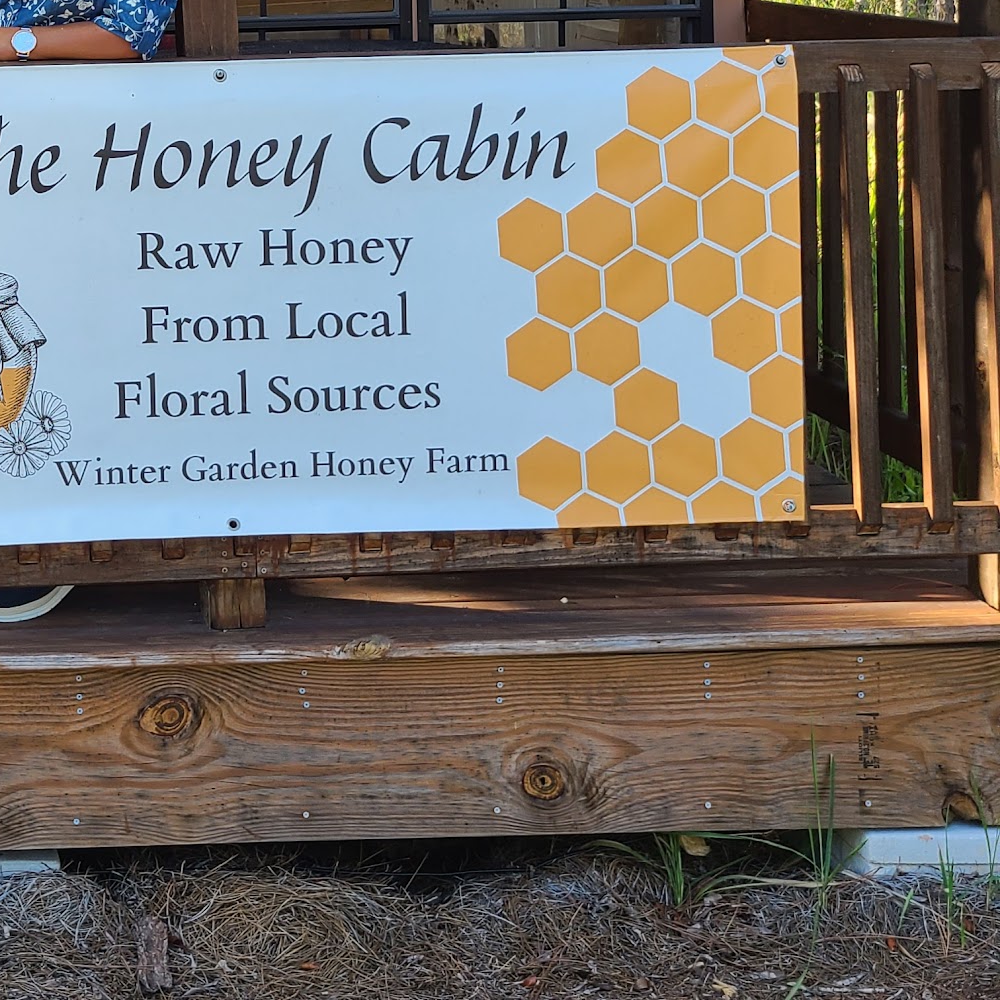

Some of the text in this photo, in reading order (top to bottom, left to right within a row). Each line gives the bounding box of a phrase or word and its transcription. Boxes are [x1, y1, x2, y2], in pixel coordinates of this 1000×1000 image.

[93, 121, 332, 217] Honey
[362, 103, 576, 184] Cabin
[137, 228, 414, 276] Raw Honey
[141, 292, 412, 344] From Local
[114, 369, 441, 420] Floral Sources
[54, 447, 511, 487] Winter Garden Honey Farm
